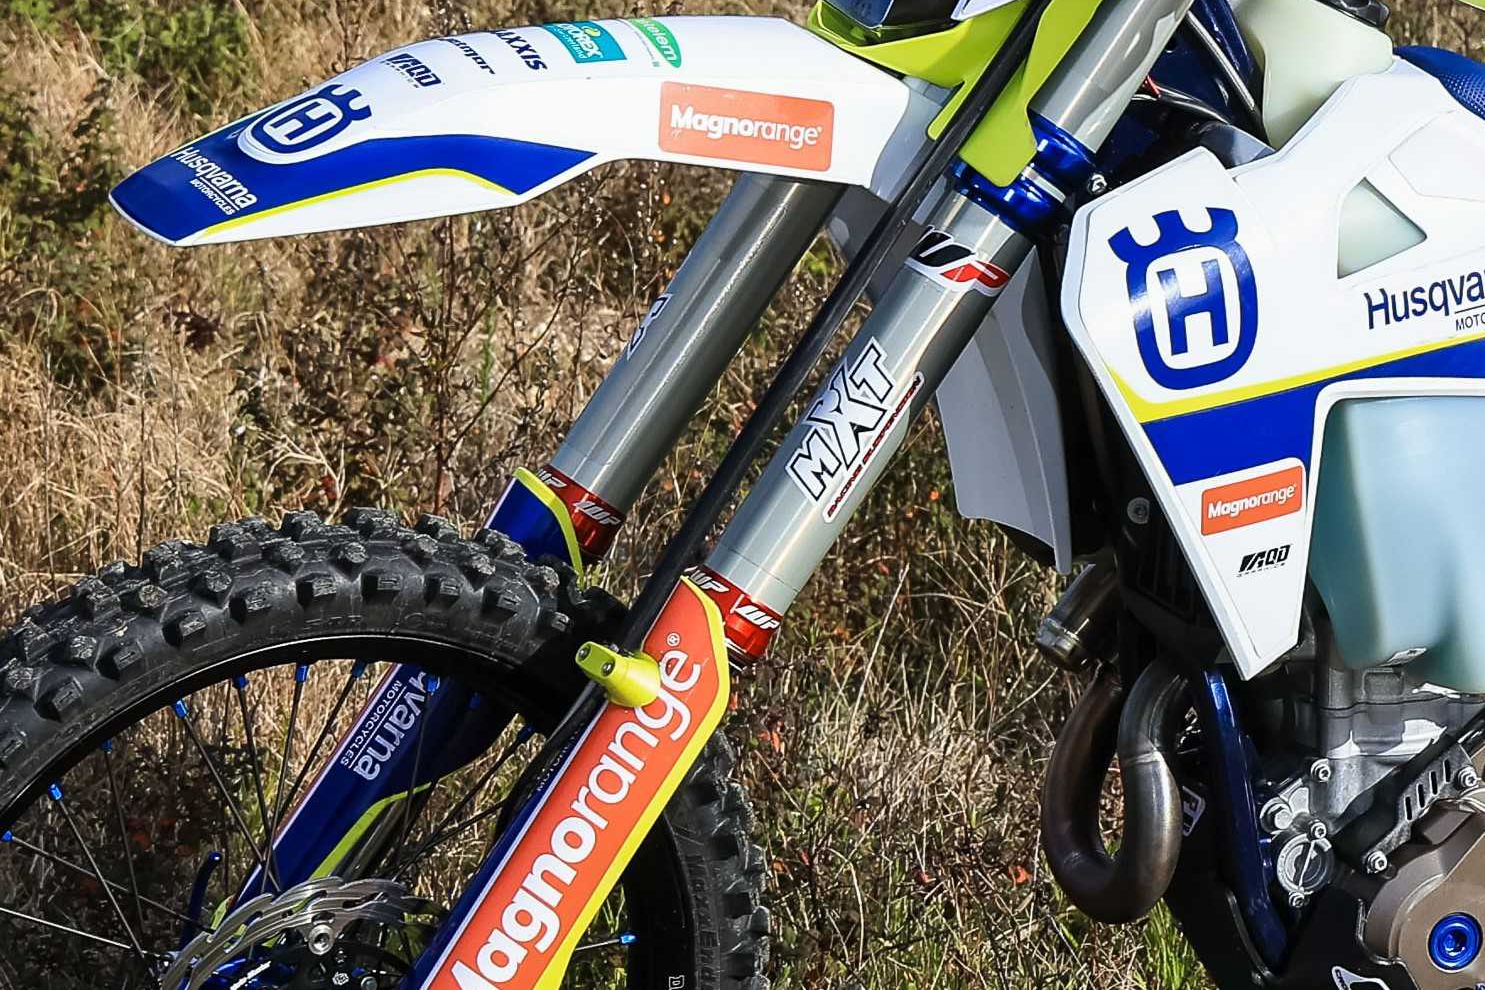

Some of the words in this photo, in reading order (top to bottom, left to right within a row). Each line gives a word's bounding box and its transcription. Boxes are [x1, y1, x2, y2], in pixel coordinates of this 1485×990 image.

[491, 30, 548, 71] AXXIS
[670, 103, 820, 150] Magnorange
[170, 146, 258, 209] Husqvarna
[189, 178, 236, 216] MOTORCYCLES
[789, 342, 894, 502] MXT
[1207, 484, 1297, 519] Magnorange
[340, 679, 403, 767] MOTORCYCLES
